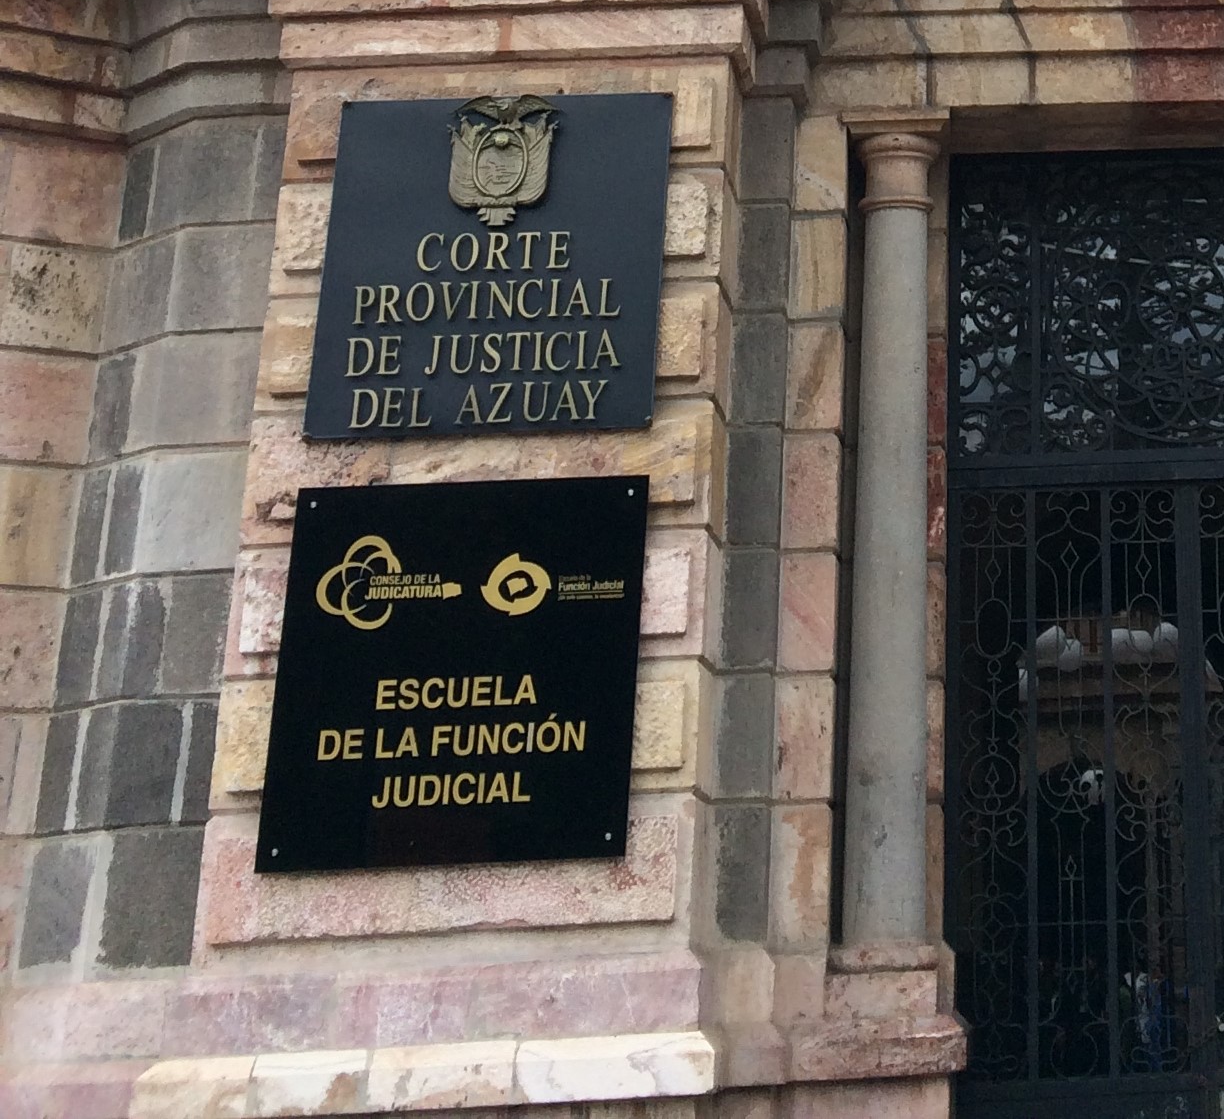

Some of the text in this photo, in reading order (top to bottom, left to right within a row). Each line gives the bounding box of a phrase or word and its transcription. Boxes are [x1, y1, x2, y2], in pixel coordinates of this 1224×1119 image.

[416, 231, 571, 272] CORTE
[351, 278, 621, 325] PROVINCIAL
[344, 329, 621, 377] DE JUSTICIA
[348, 379, 609, 429] DEL AZUAY
[364, 585, 442, 600] JUDICATURA
[369, 573, 441, 586] CONSEJO DE LA
[375, 674, 538, 710] ESCUELA
[317, 713, 586, 761] DE LA FUNCIÓN
[371, 771, 532, 809] JUDICIAL
